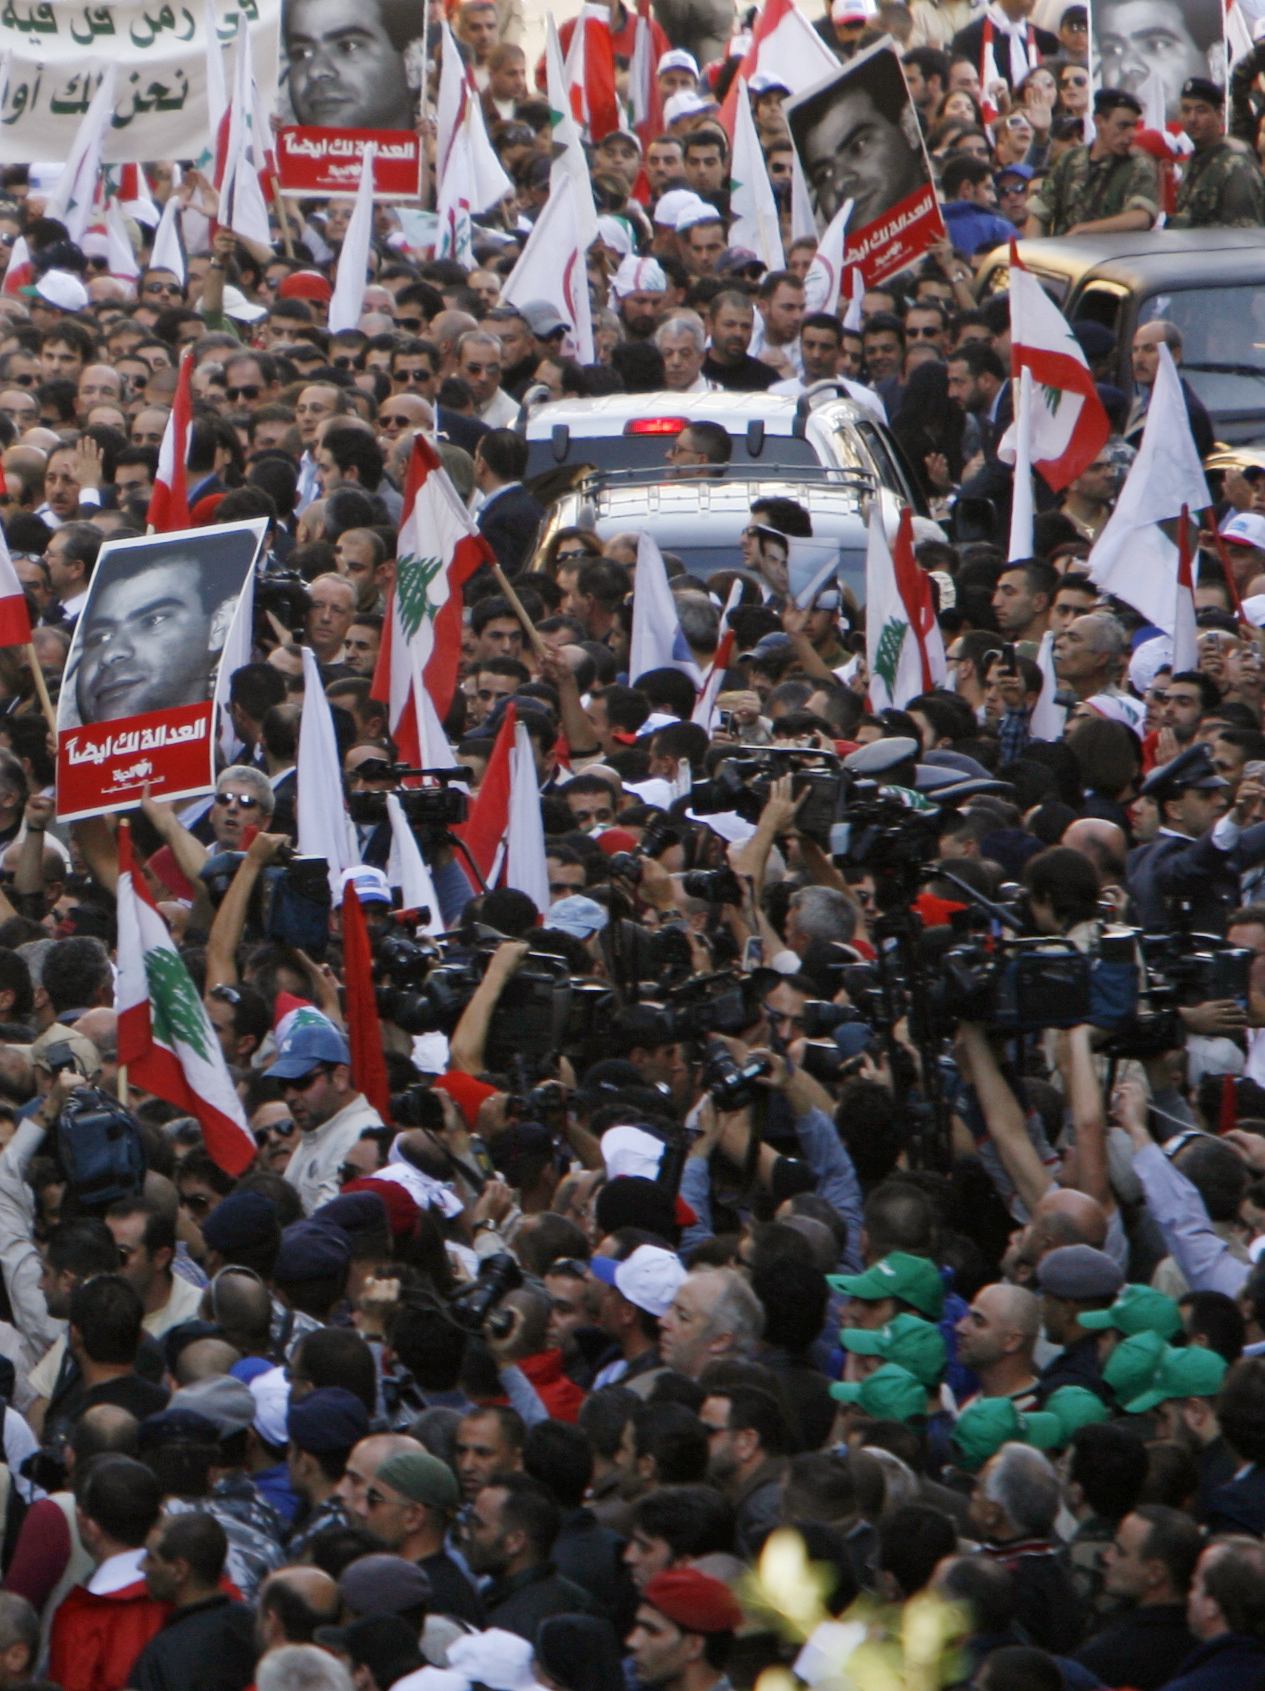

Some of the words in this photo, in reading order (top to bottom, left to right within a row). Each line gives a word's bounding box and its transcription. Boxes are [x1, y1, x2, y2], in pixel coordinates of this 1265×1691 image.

[889, 194, 934, 238] العدالة
[112, 730, 140, 756] لك
[139, 716, 207, 751] العدالة
